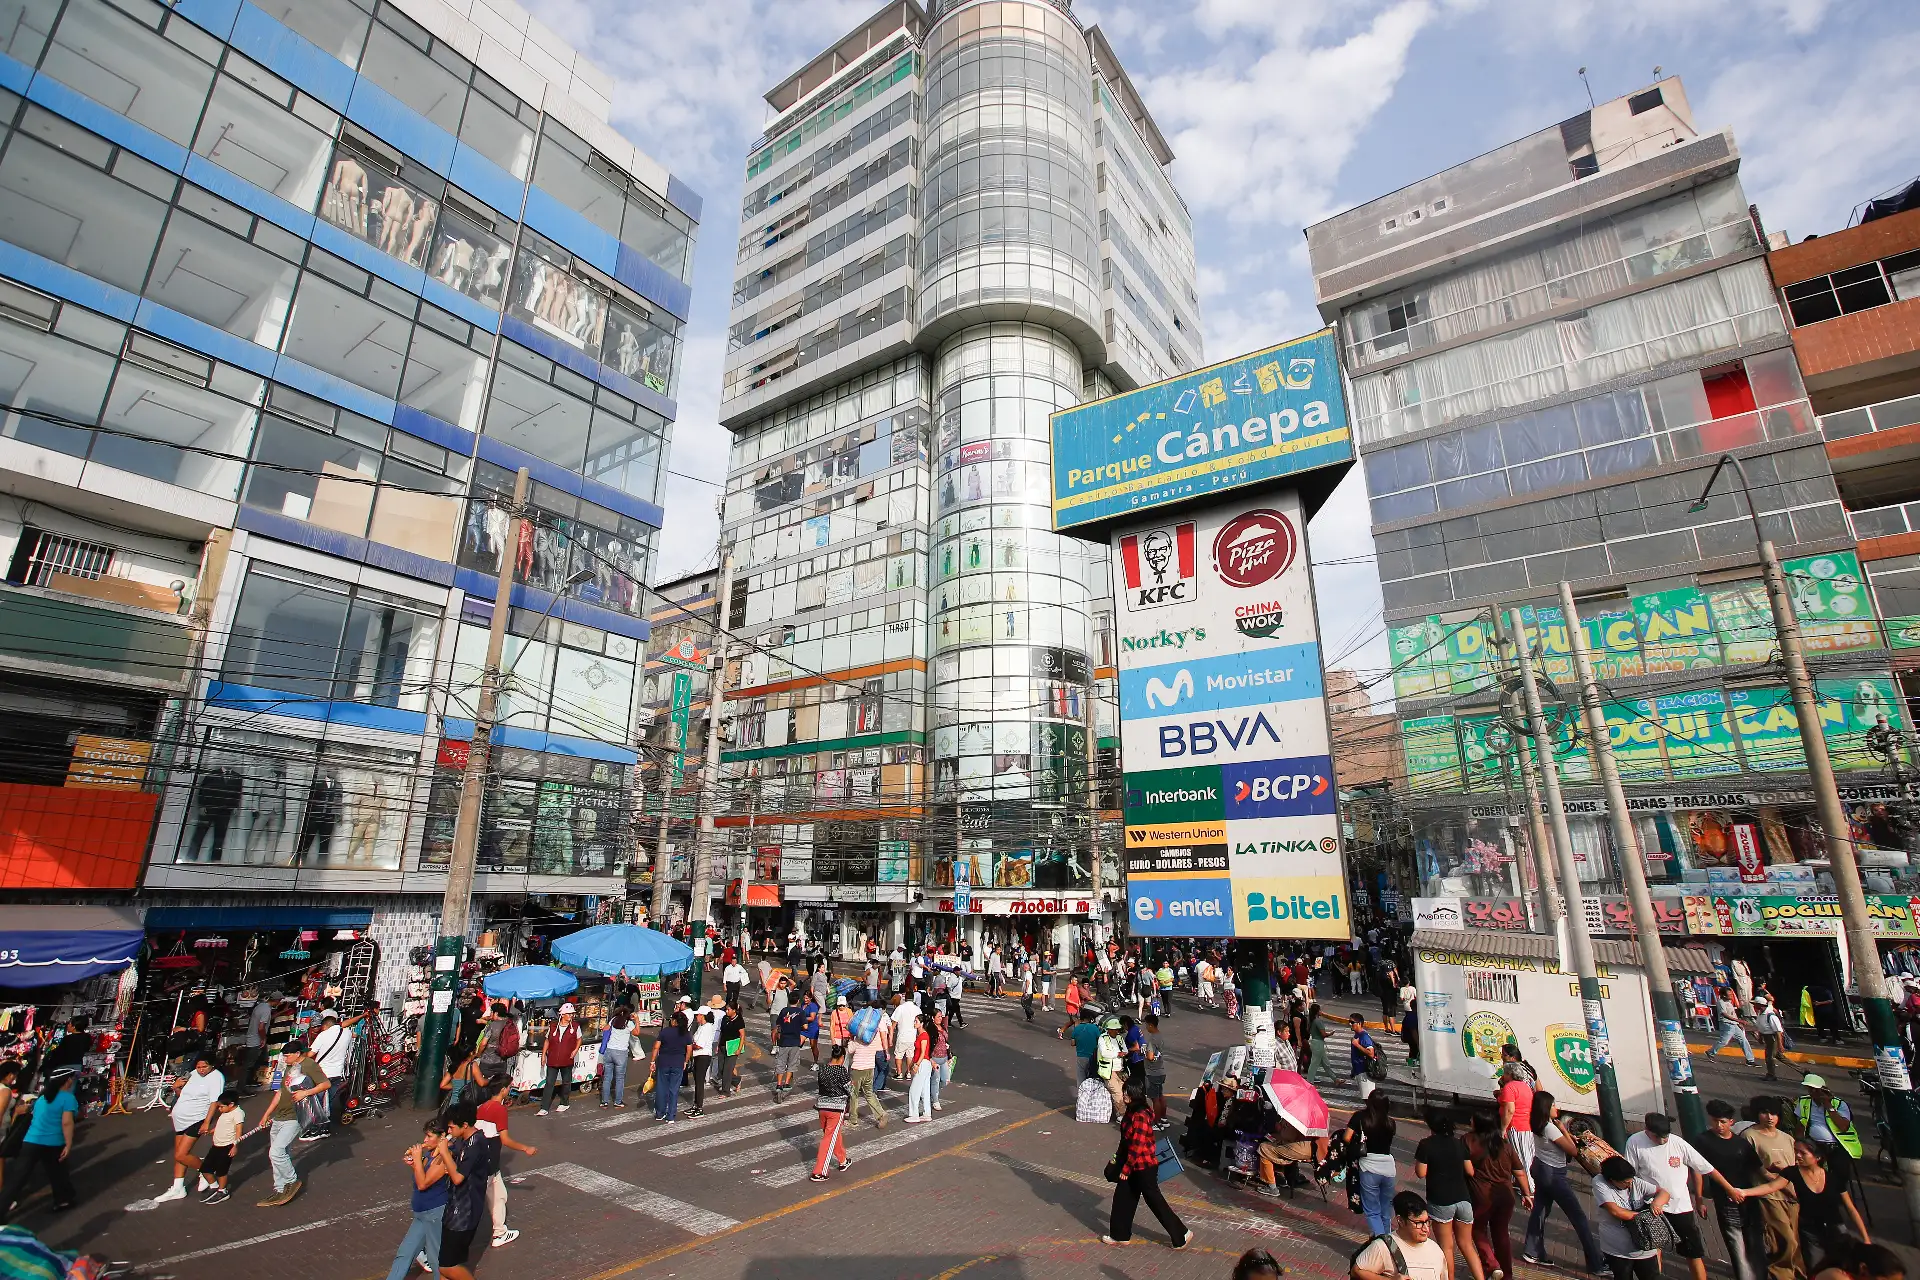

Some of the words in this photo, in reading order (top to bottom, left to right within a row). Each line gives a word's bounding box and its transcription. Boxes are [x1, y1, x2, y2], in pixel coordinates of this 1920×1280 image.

[1068, 453, 1151, 488] Parque
[1157, 400, 1330, 464] Cánepa
[1069, 486, 1120, 506] Centro
[1209, 461, 1217, 471] &
[1279, 436, 1331, 454] Court
[1131, 483, 1193, 505] Gamarra
[1212, 469, 1248, 484] Perú
[1229, 537, 1276, 567] Pizza
[1238, 549, 1275, 576] Hut
[1138, 582, 1185, 606] KFC
[1235, 600, 1282, 617] CHINA
[1241, 613, 1280, 630] WOK
[1605, 602, 1713, 652] CAN
[1121, 627, 1207, 653] Norky's
[1206, 666, 1294, 693] Movistar
[1159, 711, 1281, 758] BBVA
[1146, 787, 1217, 805] Interbank
[1251, 775, 1311, 801] BCP
[573, 797, 620, 809] TACTICAS
[1673, 794, 1745, 808] FRAZADAS
[1149, 830, 1191, 841] Western
[1192, 828, 1224, 839] Union
[1160, 848, 1192, 858] CAMBIOS
[1235, 842, 1252, 855] LA
[1740, 827, 1755, 870] INGRESO
[1129, 860, 1150, 870] EURO
[1156, 858, 1193, 870] DOLARES
[1198, 856, 1226, 868] PESOS
[1169, 898, 1223, 917] entel
[1271, 894, 1340, 919] bitel
[1761, 903, 1842, 919] DOGUI
[1865, 904, 1908, 920] AN
[1419, 950, 1537, 973] COMISARIA
[1543, 959, 1618, 980] MIL
[1483, 1014, 1510, 1031] NACIONAL
[1569, 1067, 1590, 1076] LIMA
